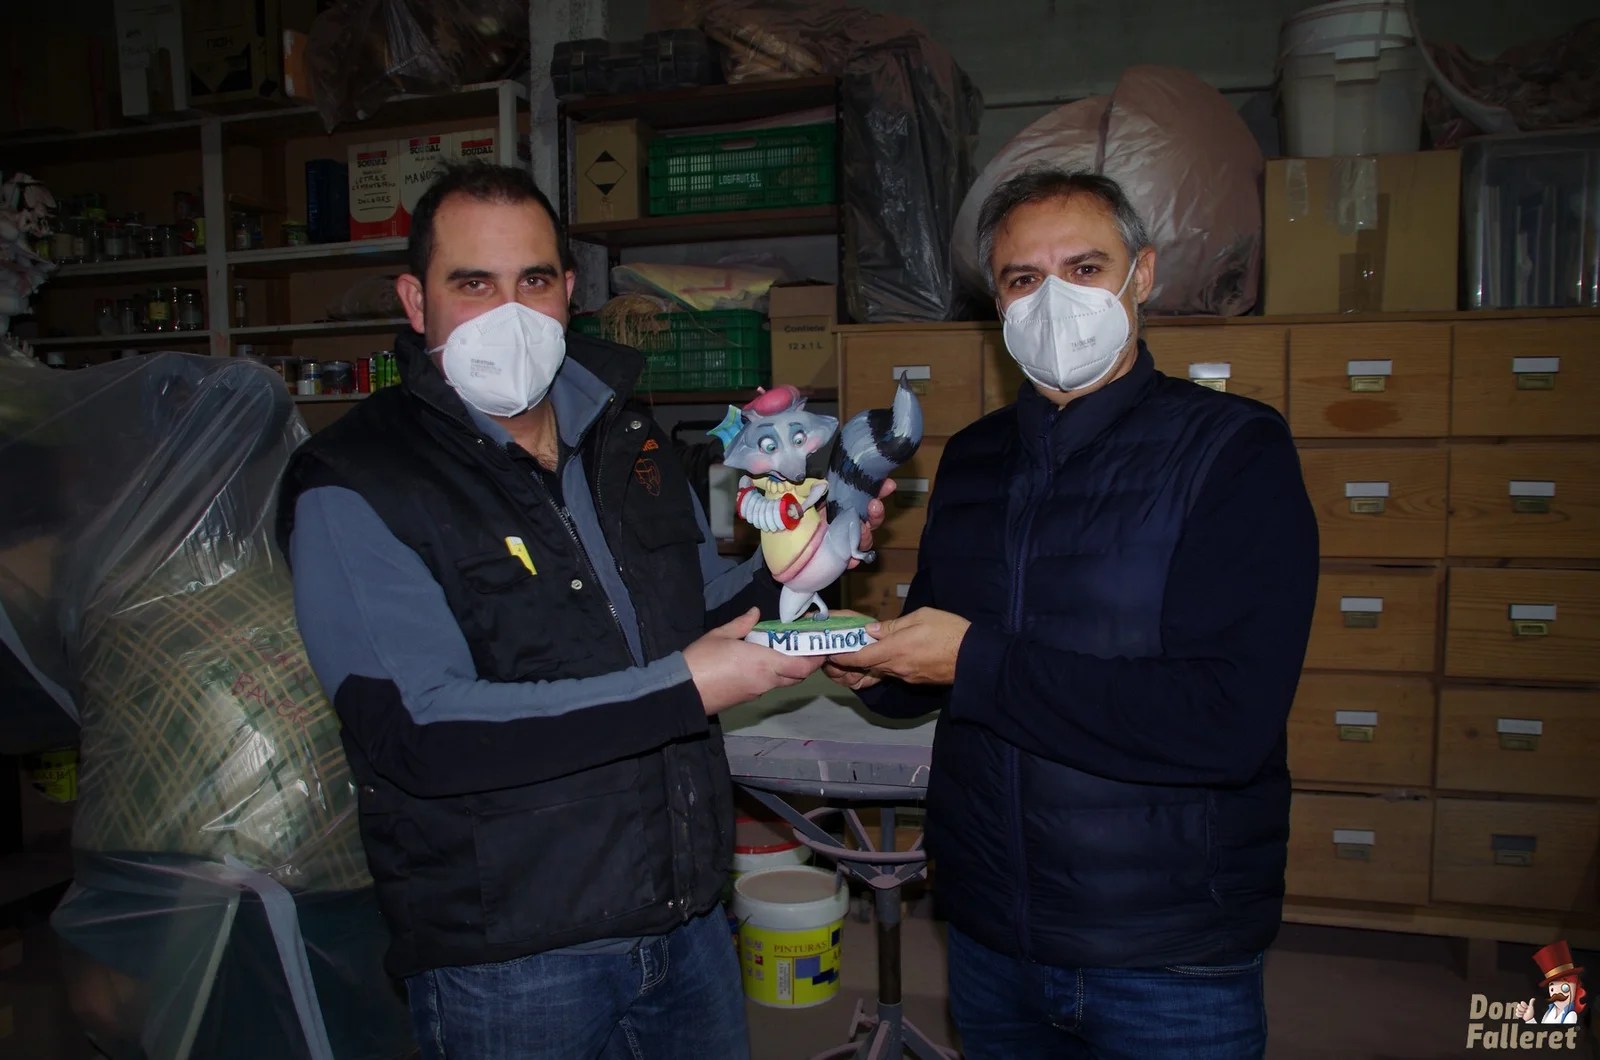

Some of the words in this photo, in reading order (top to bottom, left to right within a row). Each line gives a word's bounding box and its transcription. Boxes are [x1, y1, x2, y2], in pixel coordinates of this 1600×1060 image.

[461, 146, 494, 157] SOUDAL
[784, 324, 826, 333] Contiene
[788, 342, 799, 350] 12
[767, 628, 800, 651] Mi
[809, 628, 868, 650] ninot
[774, 941, 829, 954] PINTURAS
